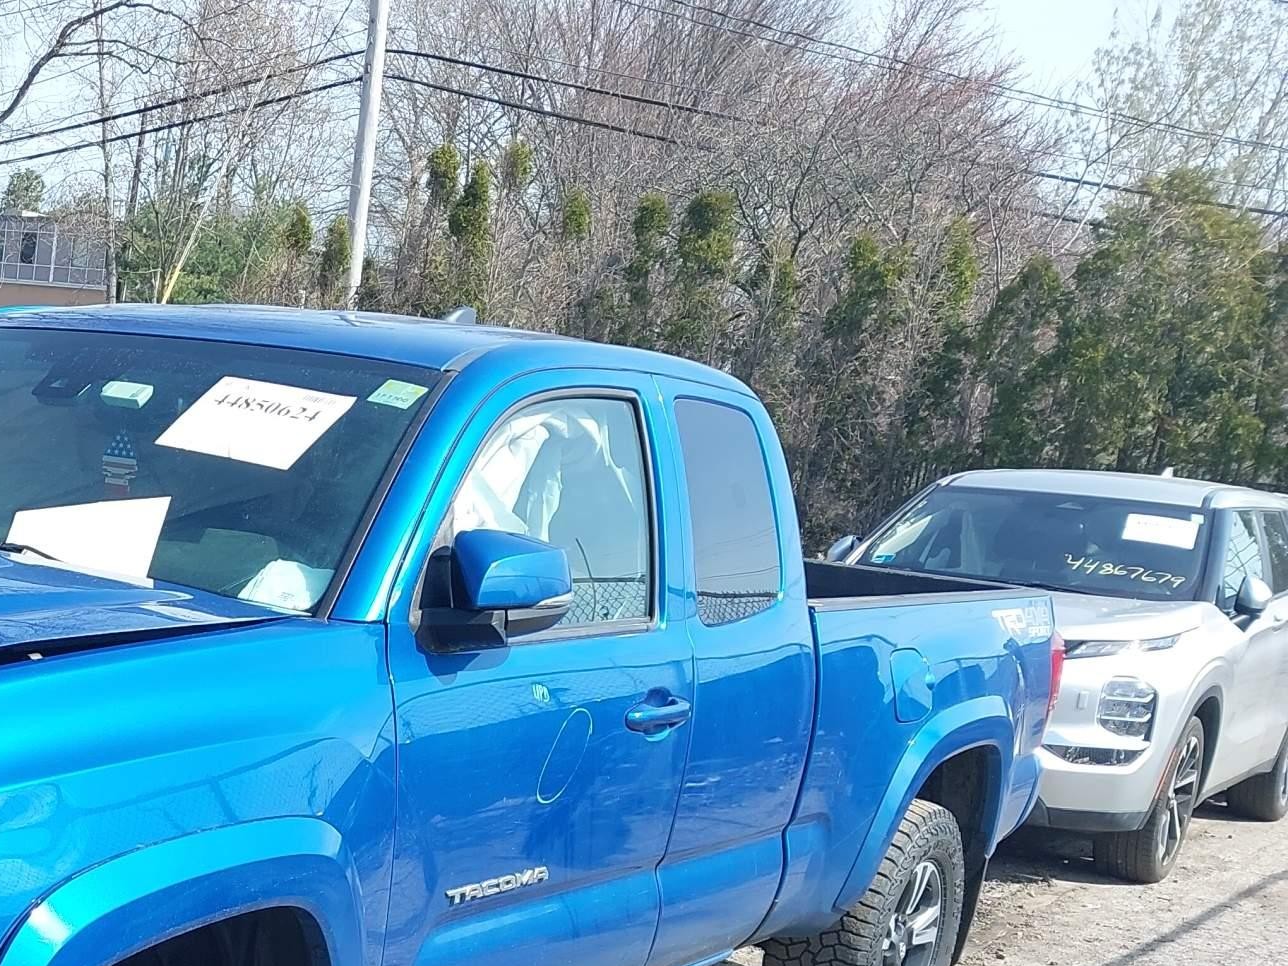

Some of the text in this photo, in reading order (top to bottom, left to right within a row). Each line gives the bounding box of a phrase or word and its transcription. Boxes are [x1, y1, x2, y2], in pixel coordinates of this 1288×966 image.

[214, 393, 322, 422] 44850624
[1064, 553, 1186, 589] 44867679
[445, 865, 550, 907] TACOMA
